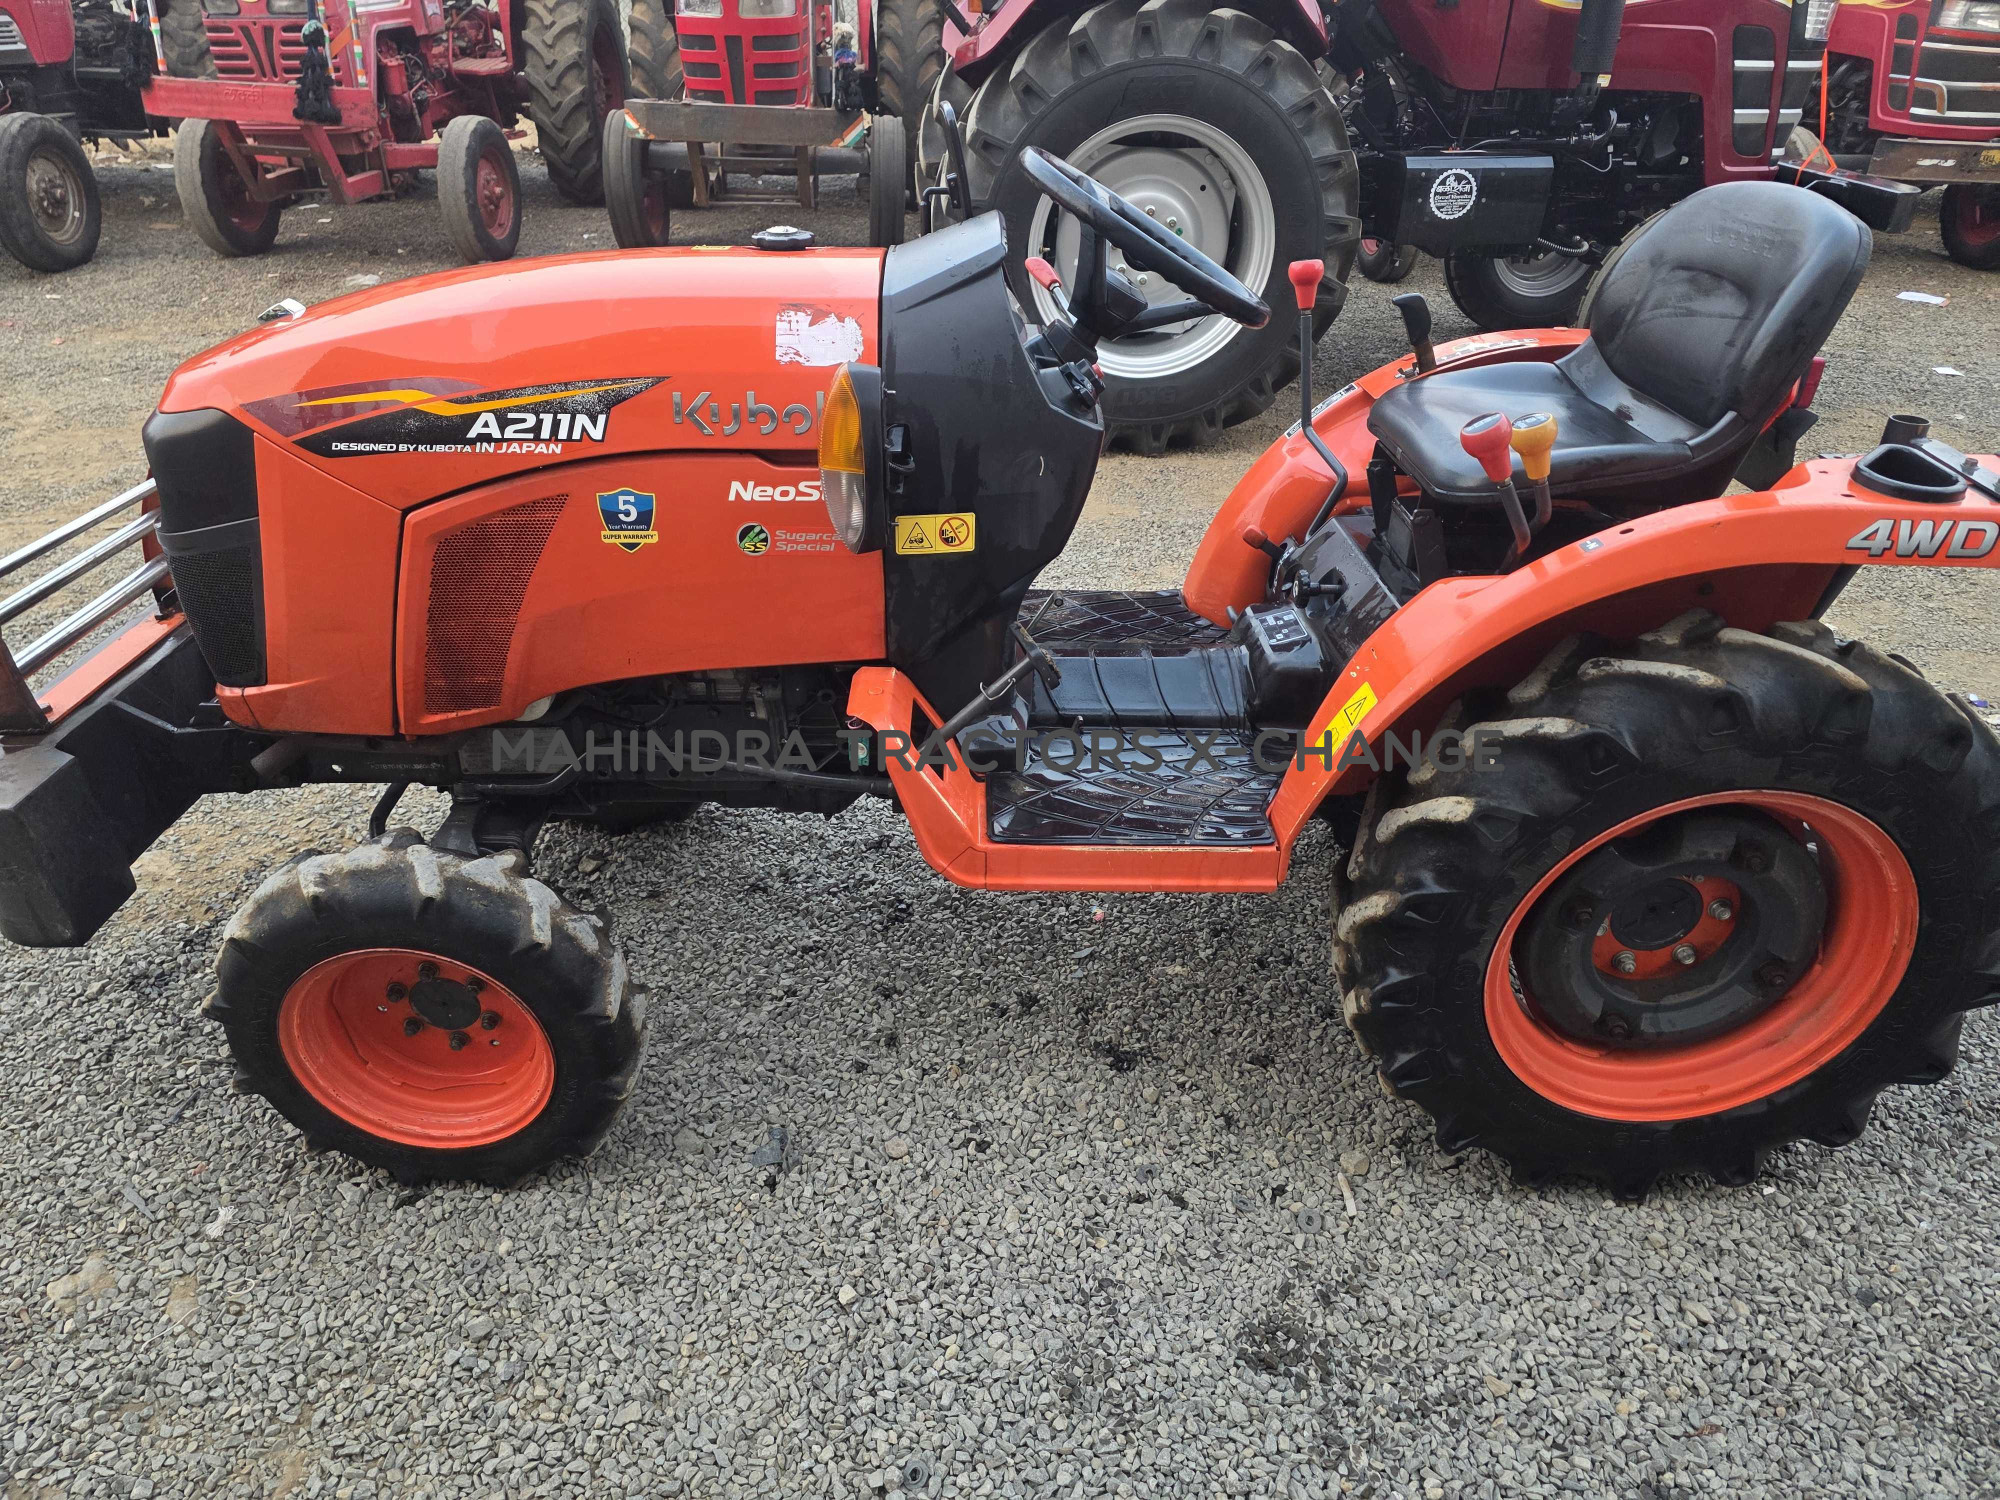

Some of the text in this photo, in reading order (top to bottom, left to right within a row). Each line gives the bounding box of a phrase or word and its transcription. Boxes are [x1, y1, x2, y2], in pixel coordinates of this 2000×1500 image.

[466, 412, 607, 442] A211N
[331, 441, 562, 454] DESIGNED BY KUBOTA IN JAPAN
[617, 495, 638, 522] 5
[621, 523, 648, 531] Warranty
[1846, 519, 2000, 559] 4WD
[743, 542, 767, 551] SS
[775, 542, 835, 552] Special
